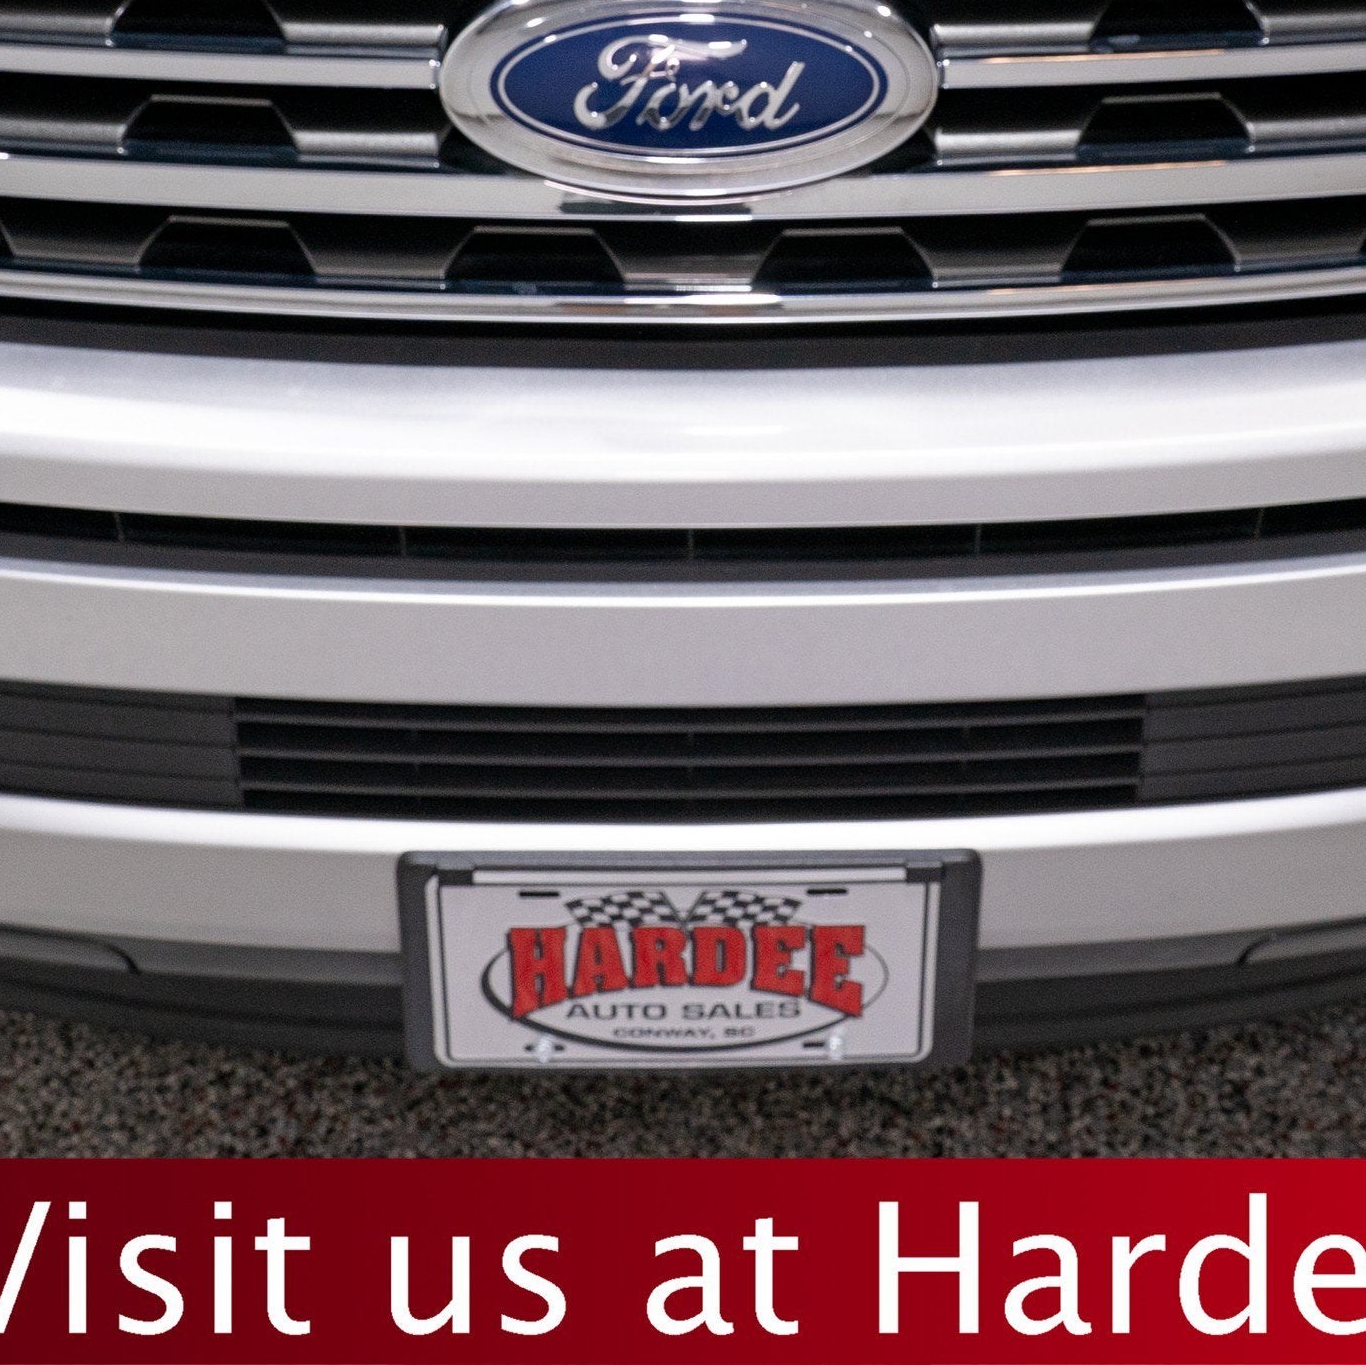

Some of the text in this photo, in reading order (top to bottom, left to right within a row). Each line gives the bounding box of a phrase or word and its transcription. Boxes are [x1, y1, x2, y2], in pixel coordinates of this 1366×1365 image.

[574, 34, 805, 130] Ford
[507, 924, 866, 1021] HARDEE
[566, 1001, 802, 1020] AUTO SALES
